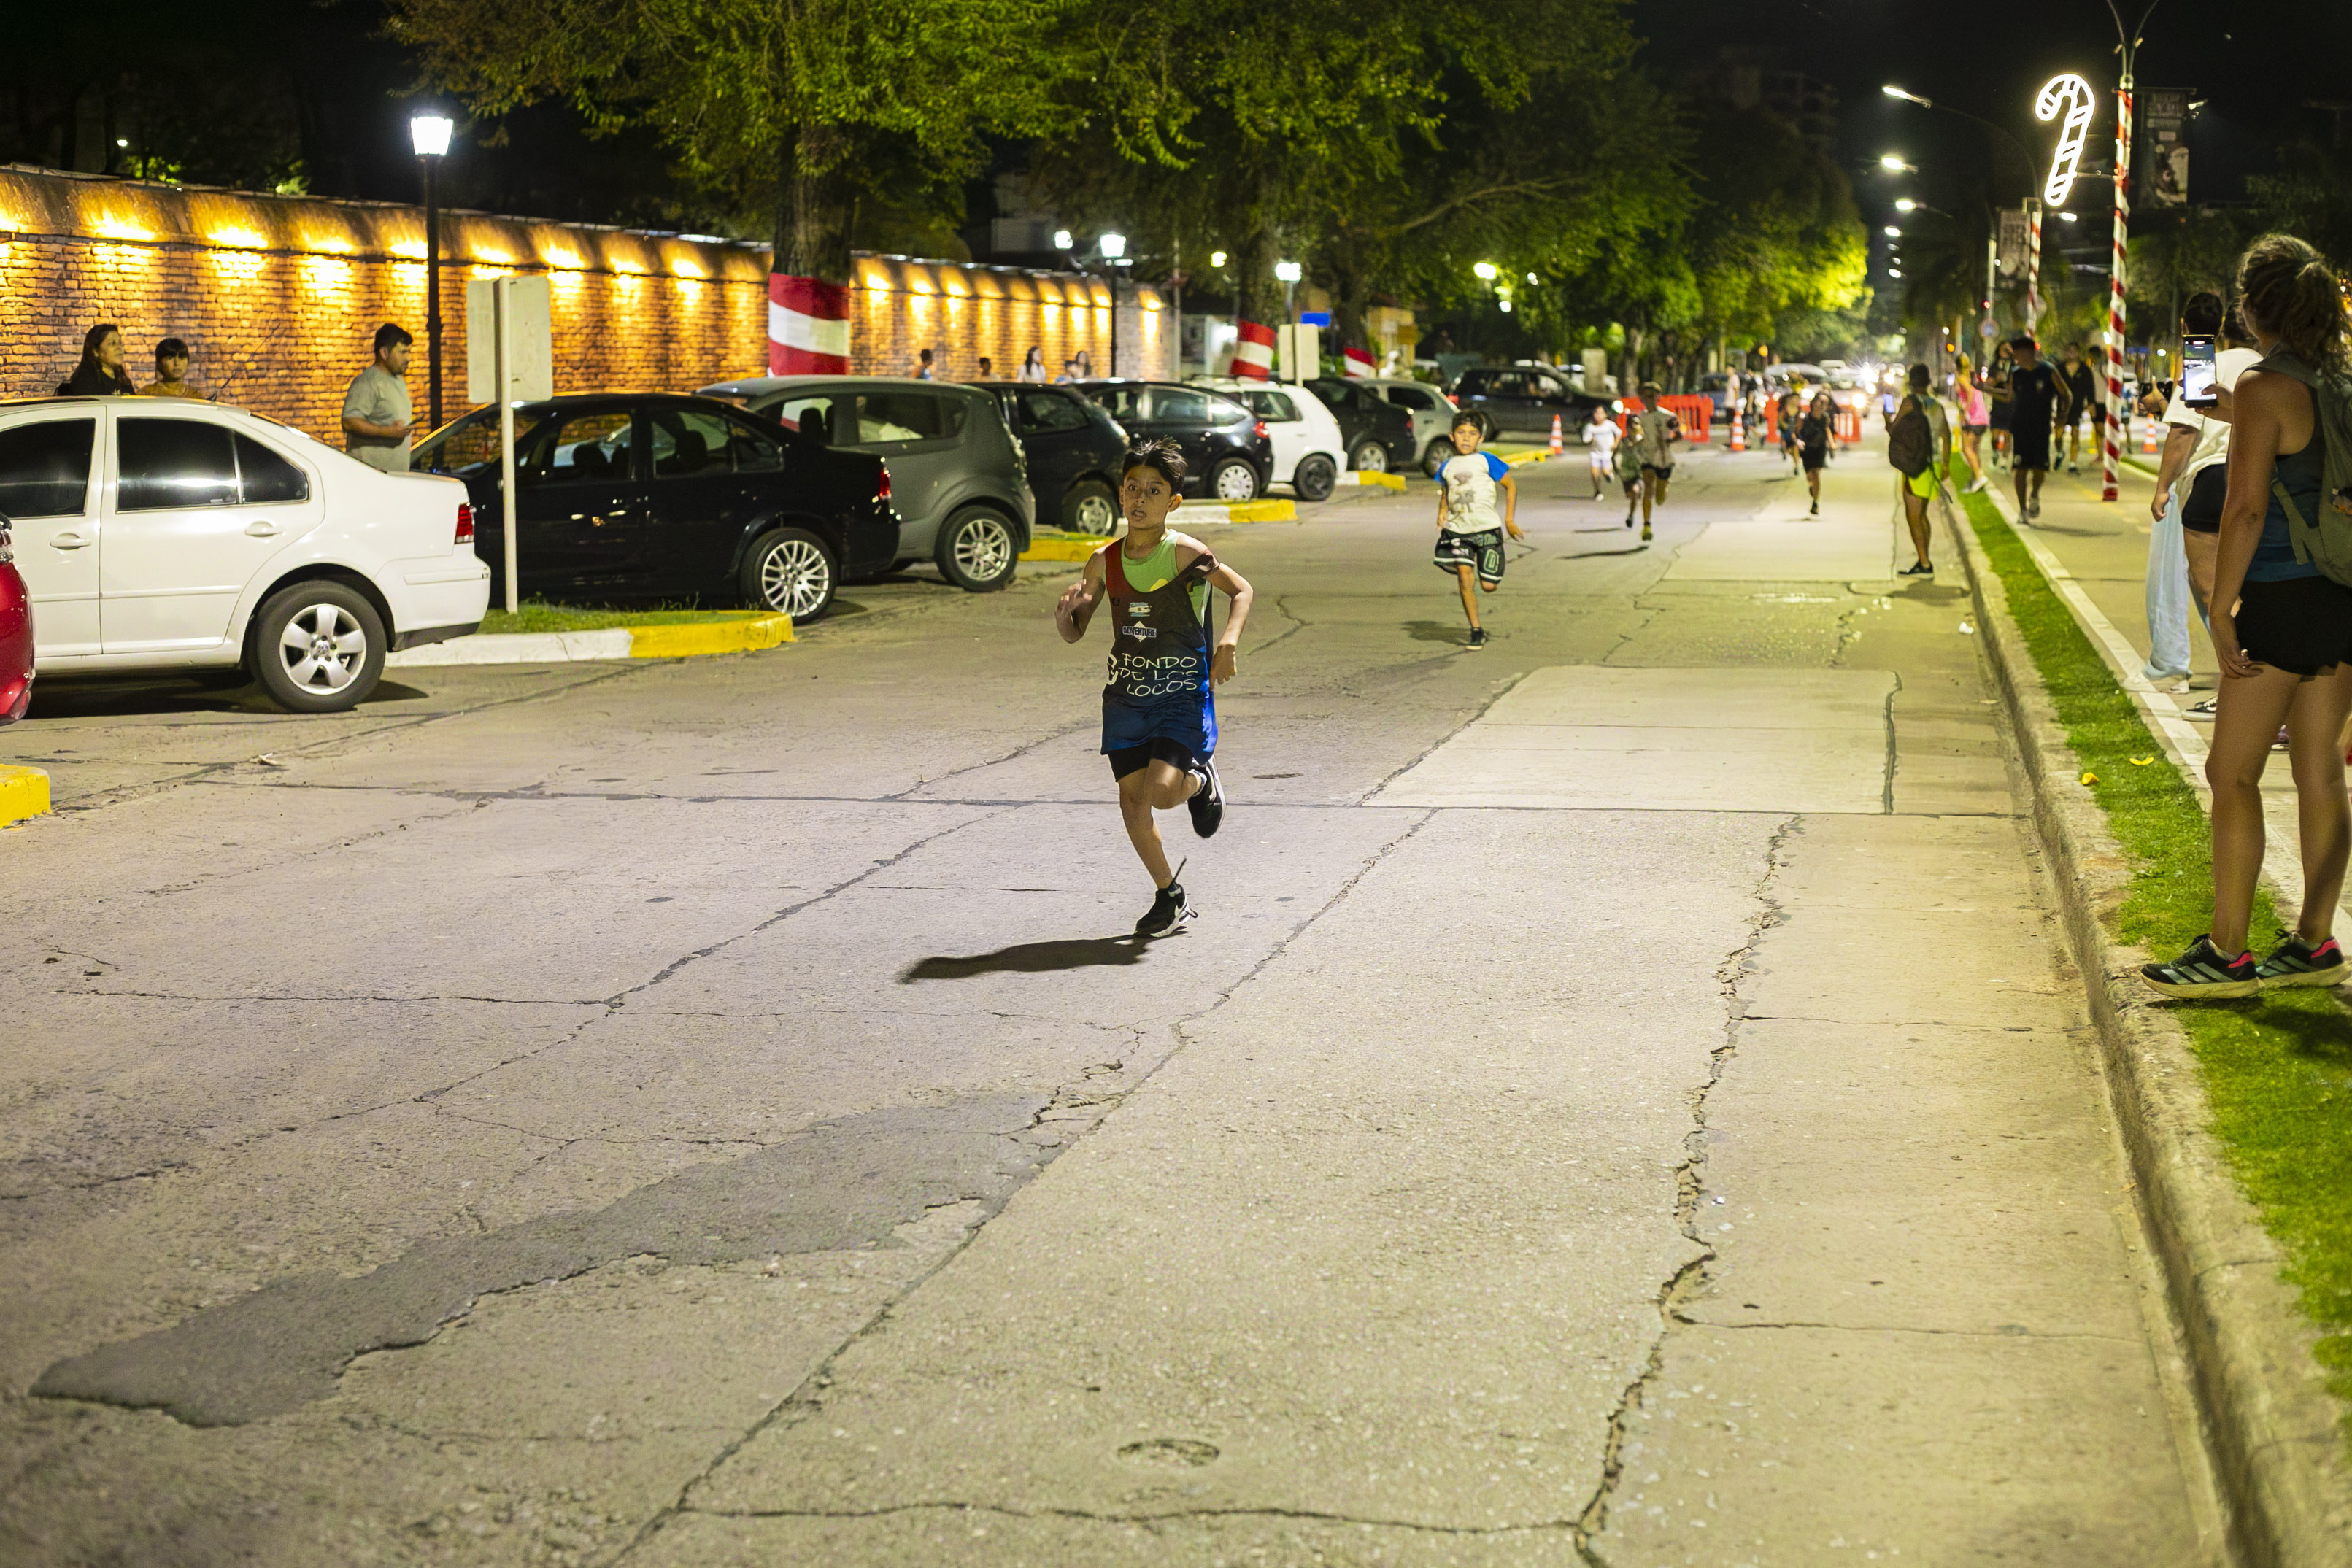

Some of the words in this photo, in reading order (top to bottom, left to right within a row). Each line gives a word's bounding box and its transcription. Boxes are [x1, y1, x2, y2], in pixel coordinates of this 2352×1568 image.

[1123, 627, 1157, 637] ADVENTURE
[1122, 653, 1197, 669] FONDO
[1118, 667, 1144, 681] DE
[1127, 679, 1198, 697] LOCOS
